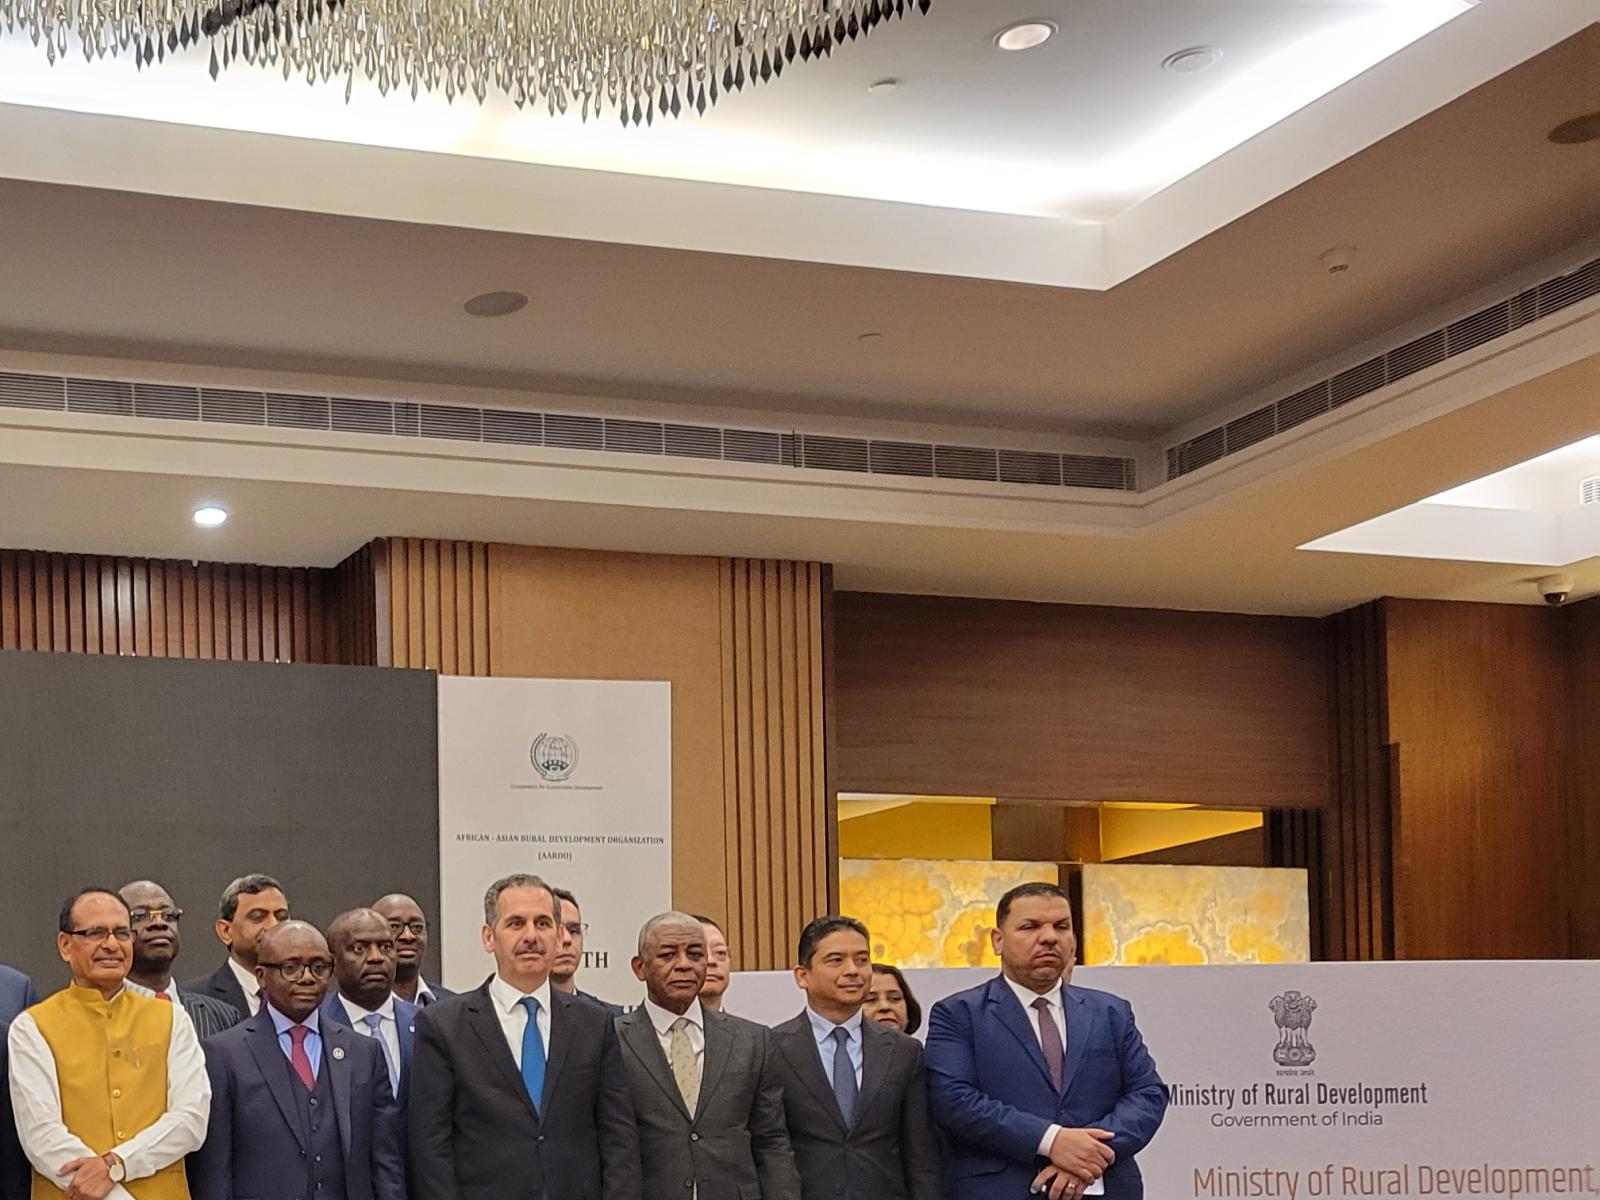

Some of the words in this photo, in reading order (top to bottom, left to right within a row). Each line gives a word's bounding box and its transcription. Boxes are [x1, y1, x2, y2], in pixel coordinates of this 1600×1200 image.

[456, 834, 489, 842] AFRICAN
[549, 835, 606, 844] DEVELOPMENT
[608, 836, 664, 845] ORGANIZATION
[1167, 1084, 1235, 1109] Ministry
[1242, 1084, 1258, 1105] of
[1265, 1083, 1309, 1105] Rural
[1317, 1082, 1428, 1108] Development
[1211, 1112, 1317, 1127] Government
[1322, 1112, 1338, 1126] of
[1343, 1112, 1383, 1126] India
[1308, 1164, 1334, 1196] of
[1342, 1164, 1408, 1195] Rural
